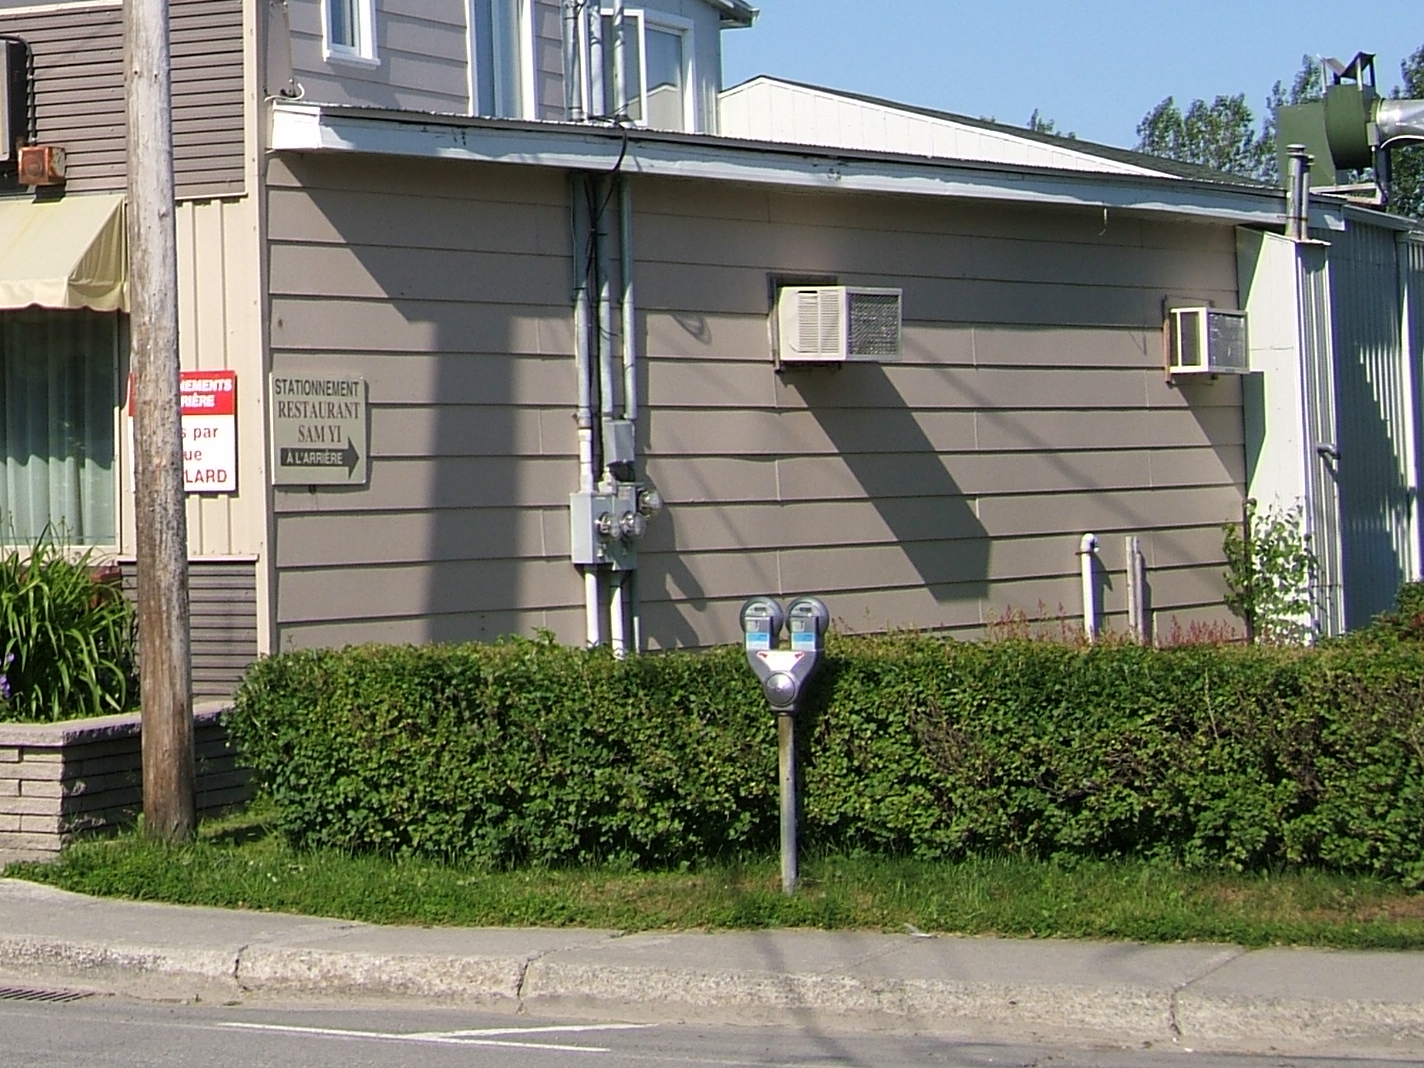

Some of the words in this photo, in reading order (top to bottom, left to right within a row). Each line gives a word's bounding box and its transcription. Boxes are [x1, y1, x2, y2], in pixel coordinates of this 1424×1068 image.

[274, 378, 360, 396] STATIONNEMENT
[278, 400, 360, 420] RESTAURANT
[193, 427, 219, 441] par
[297, 425, 325, 443] SAM
[328, 425, 342, 443] YI
[287, 449, 294, 464] À
[295, 450, 343, 464] L'ARRIÈRE
